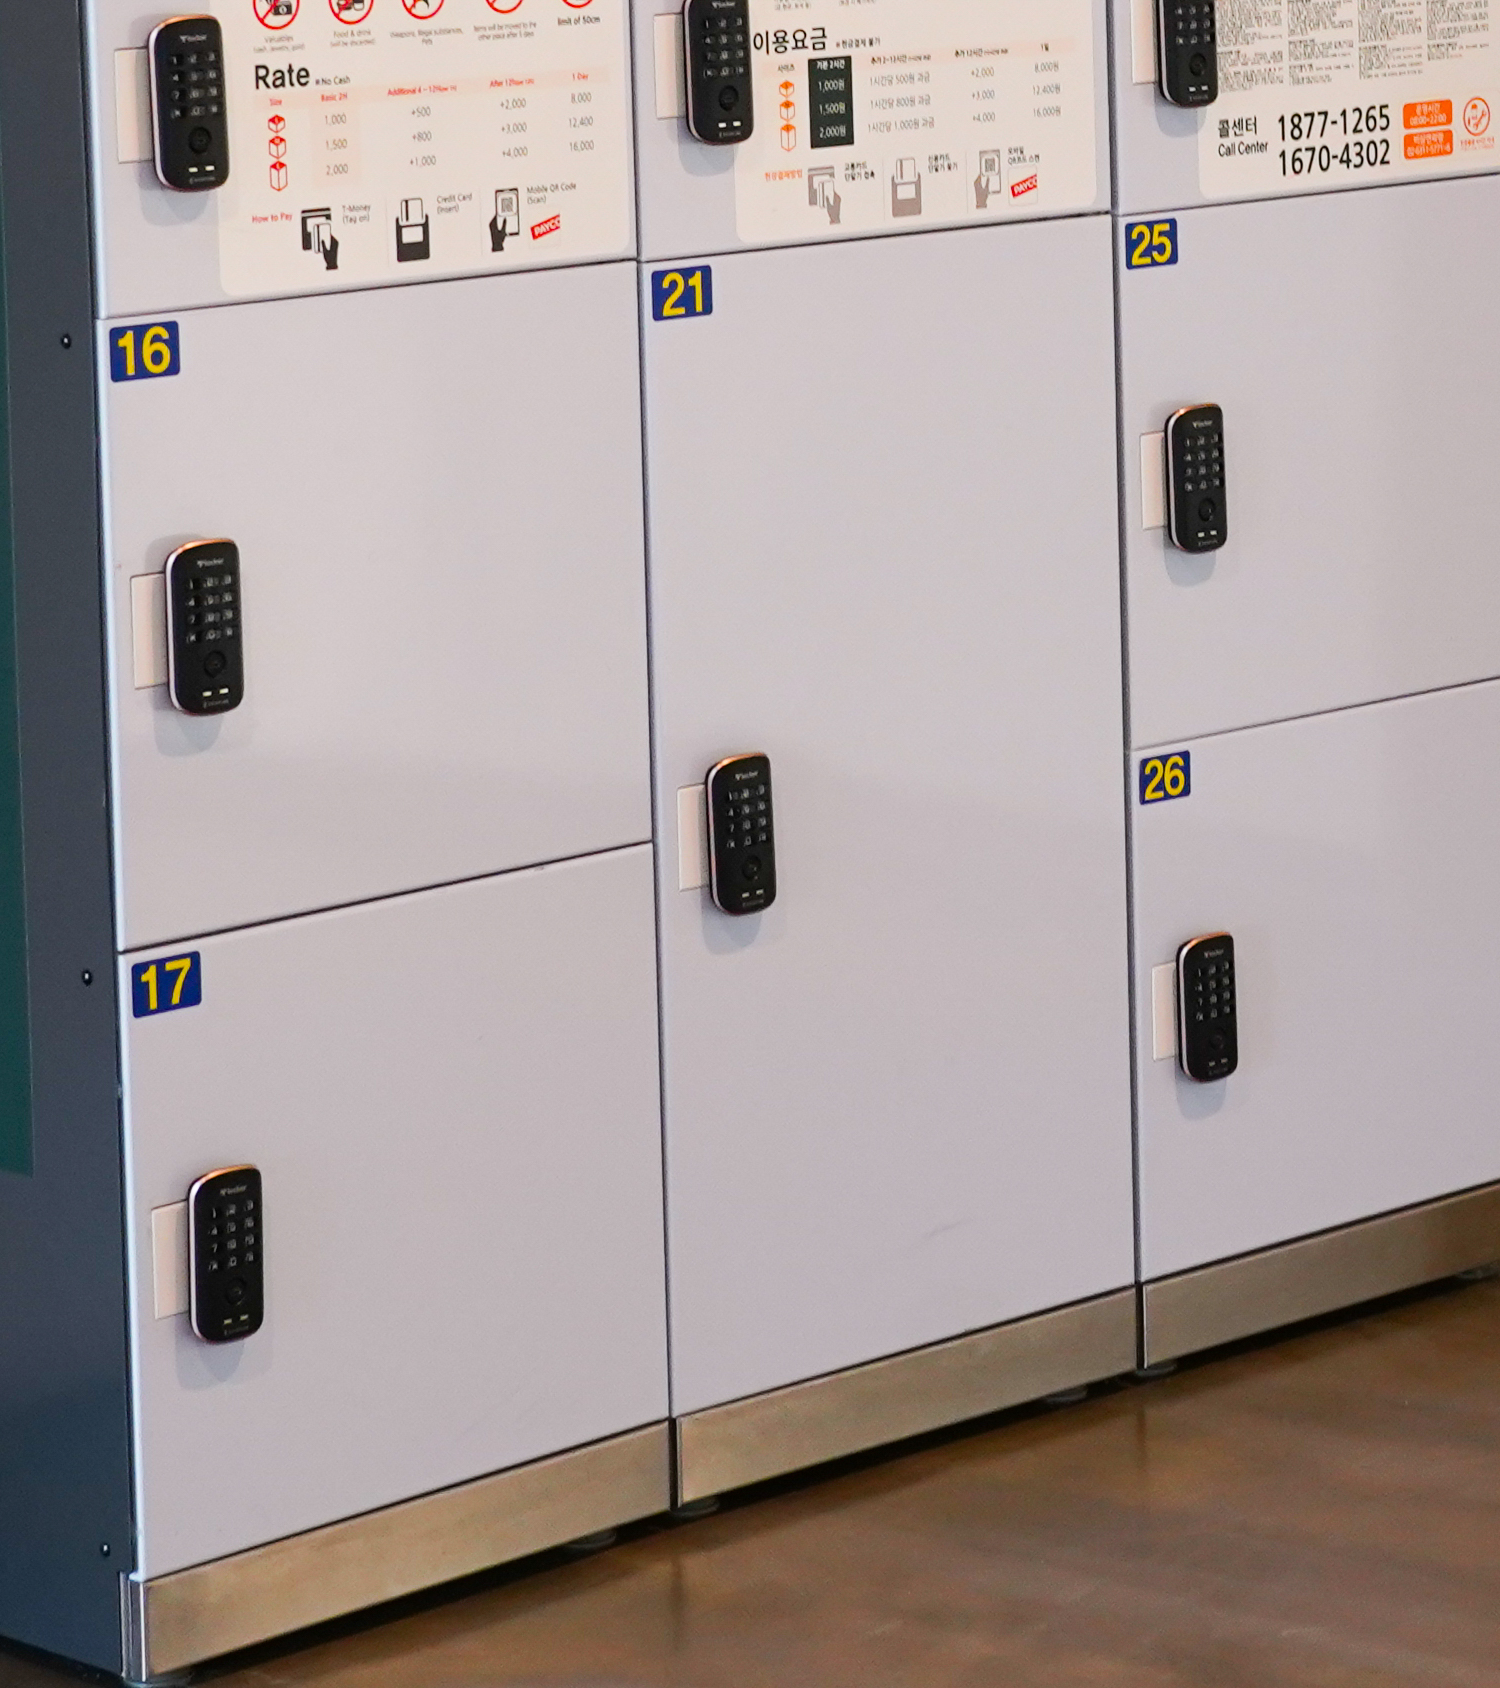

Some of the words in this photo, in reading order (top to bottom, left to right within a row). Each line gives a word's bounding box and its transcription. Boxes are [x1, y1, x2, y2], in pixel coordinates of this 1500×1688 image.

[753, 27, 827, 55] 이용요금
[255, 63, 310, 90] Rate
[333, 75, 350, 85] Cash
[818, 78, 845, 94] 1,000원
[324, 113, 347, 126] 1,000
[411, 106, 431, 118] +500
[500, 97, 527, 110] +2,000
[570, 92, 592, 104] 8,000
[819, 101, 845, 116] 1,500원
[1217, 115, 1257, 139] 콜센터
[1278, 104, 1390, 142] 1877-1265
[325, 138, 348, 152] 1,500
[412, 130, 432, 142] +800
[501, 122, 527, 134] +3,000
[569, 116, 594, 129] 12,400
[819, 124, 846, 139] 2,000원
[326, 163, 349, 176] 2,000
[409, 155, 436, 167] +1,000
[502, 146, 528, 158] +4,000
[569, 139, 595, 152] 16,000
[1218, 142, 1235, 157] Call
[1237, 140, 1269, 155] Center
[1278, 138, 1391, 177] 1670-4302
[437, 194, 456, 204] Credit
[457, 192, 473, 203] Card
[252, 214, 270, 223] How
[271, 214, 279, 222] to
[280, 213, 293, 222] Pay
[1129, 223, 1173, 266] 25
[662, 271, 703, 317] 21
[116, 326, 173, 377] 16
[1144, 757, 1186, 798] 26
[139, 958, 196, 1013] 17
